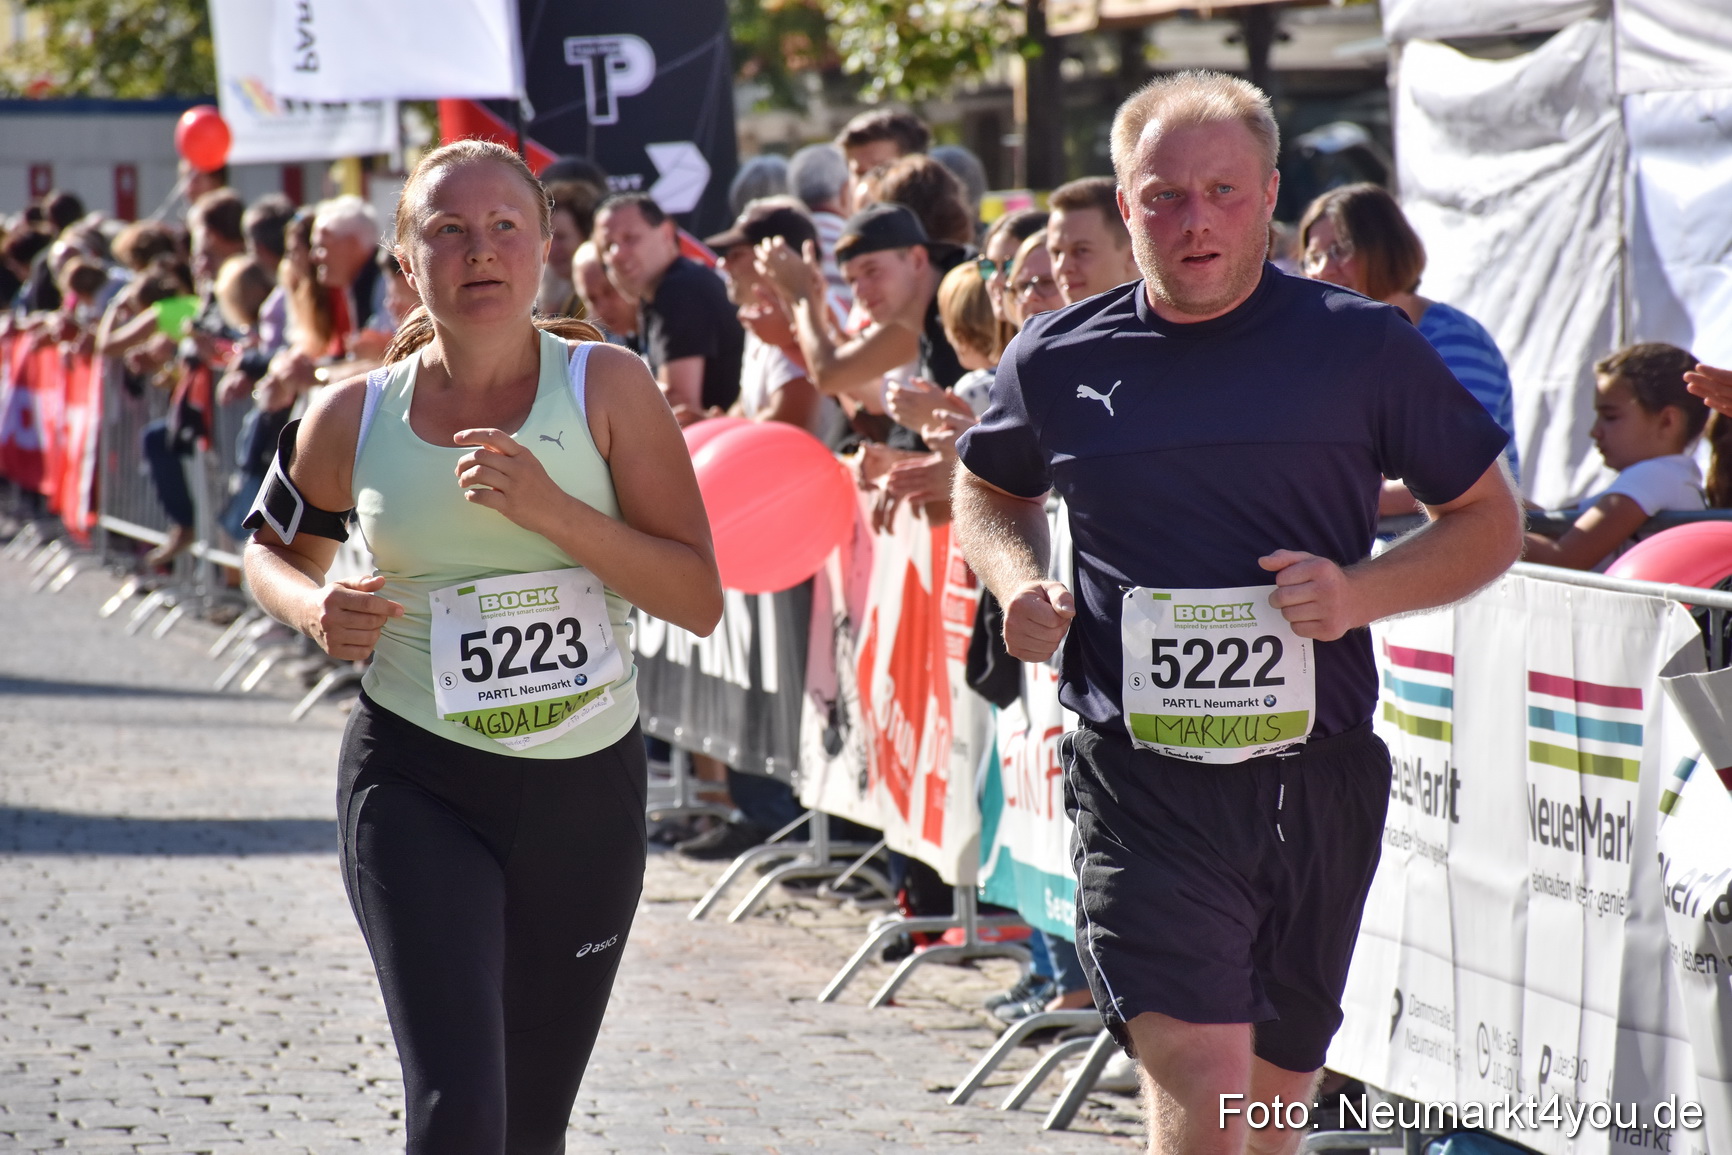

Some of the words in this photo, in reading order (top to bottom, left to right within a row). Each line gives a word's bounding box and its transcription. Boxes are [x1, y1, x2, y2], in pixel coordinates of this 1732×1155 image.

[479, 586, 560, 613] BOCK
[481, 611, 507, 620] inspired
[507, 609, 516, 617] by
[517, 608, 535, 616] smart
[535, 605, 560, 613] concepts
[1173, 602, 1256, 623] BOCK
[1174, 622, 1200, 630] inspired
[1200, 622, 1209, 630] by
[1229, 621, 1258, 629] concepts
[460, 617, 588, 683] 5223
[1151, 635, 1285, 690] 5222
[478, 688, 518, 701] PARTL
[519, 679, 572, 696] Neumarkt
[1162, 698, 1201, 709] PARTL
[1204, 698, 1259, 709] Neumarkt
[1155, 714, 1282, 747] MARKUS
[592, 933, 619, 953] asics
